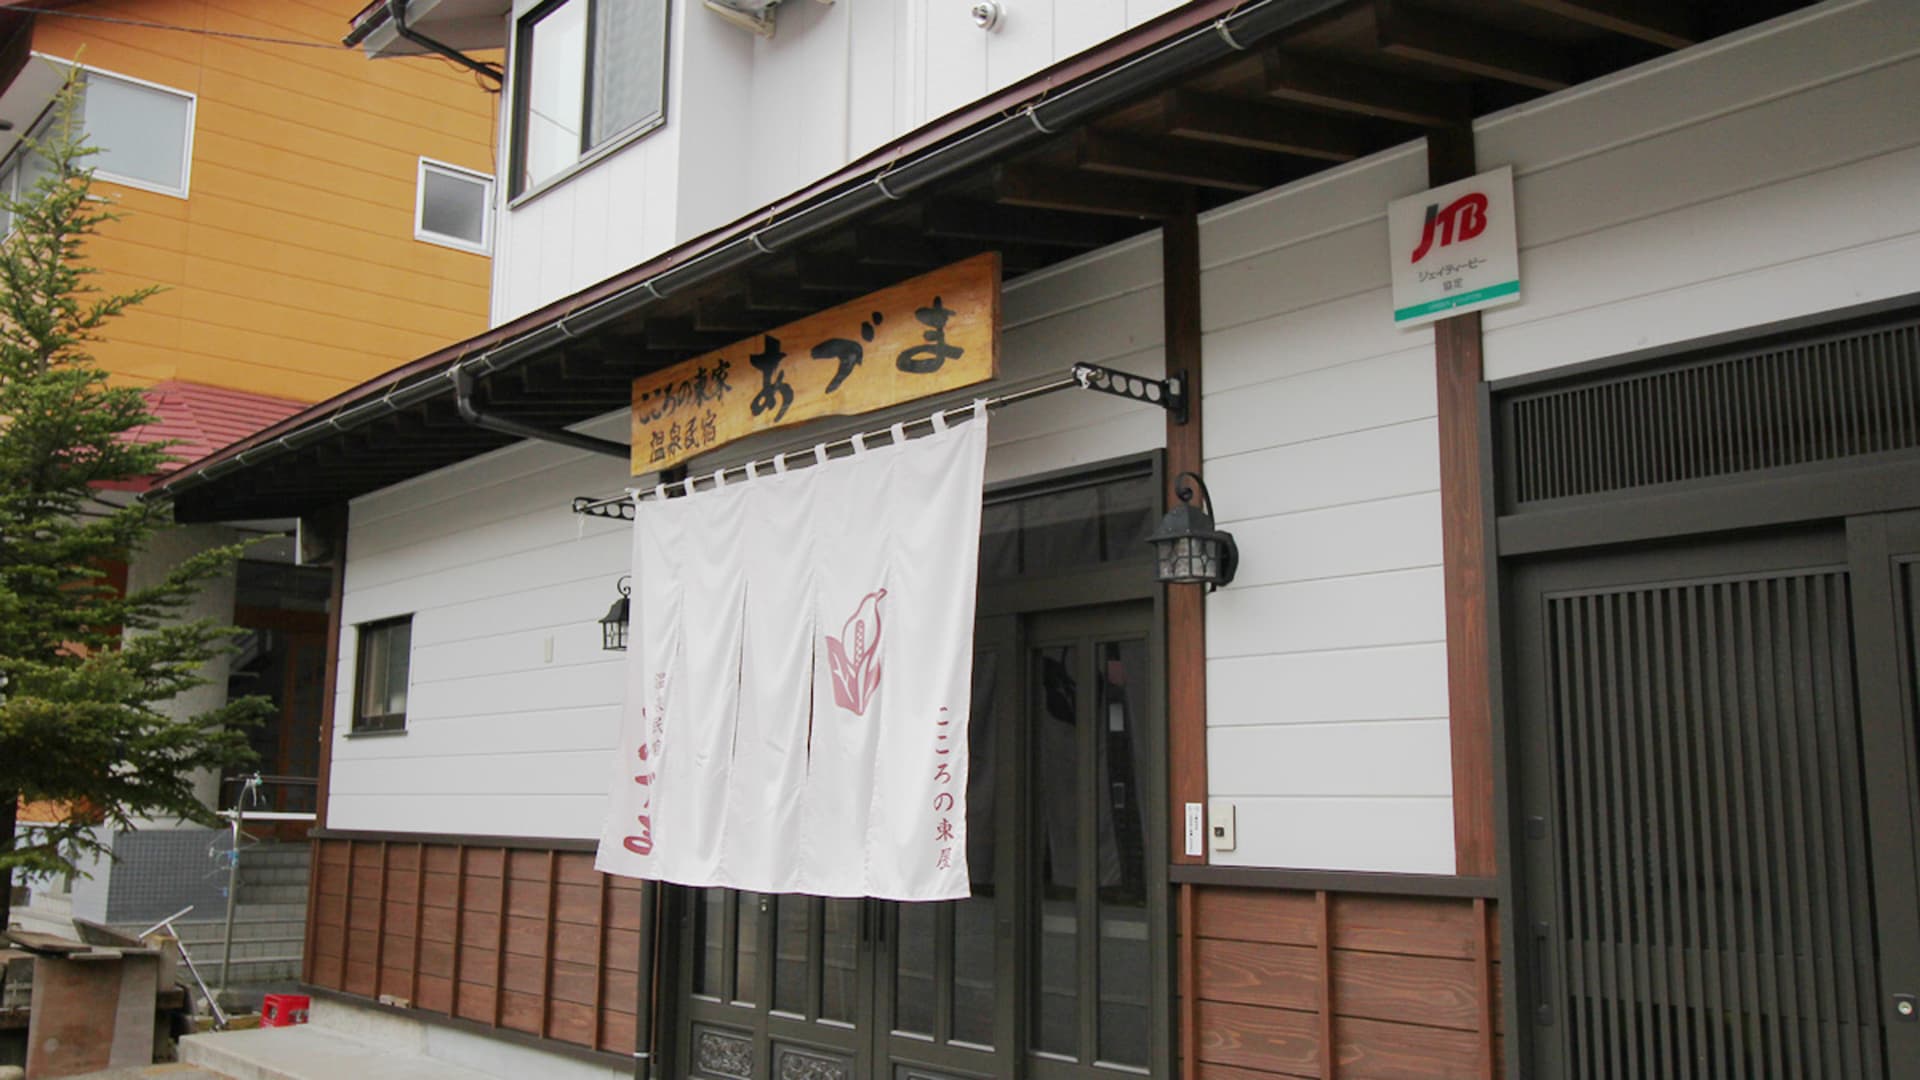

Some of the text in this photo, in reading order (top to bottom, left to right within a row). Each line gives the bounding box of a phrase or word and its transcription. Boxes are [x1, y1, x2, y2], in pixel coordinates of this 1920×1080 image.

[1411, 192, 1488, 264] JTB
[750, 295, 964, 422] あづま
[649, 409, 717, 463] 温泉民宿
[933, 706, 955, 870] こころの東屋
